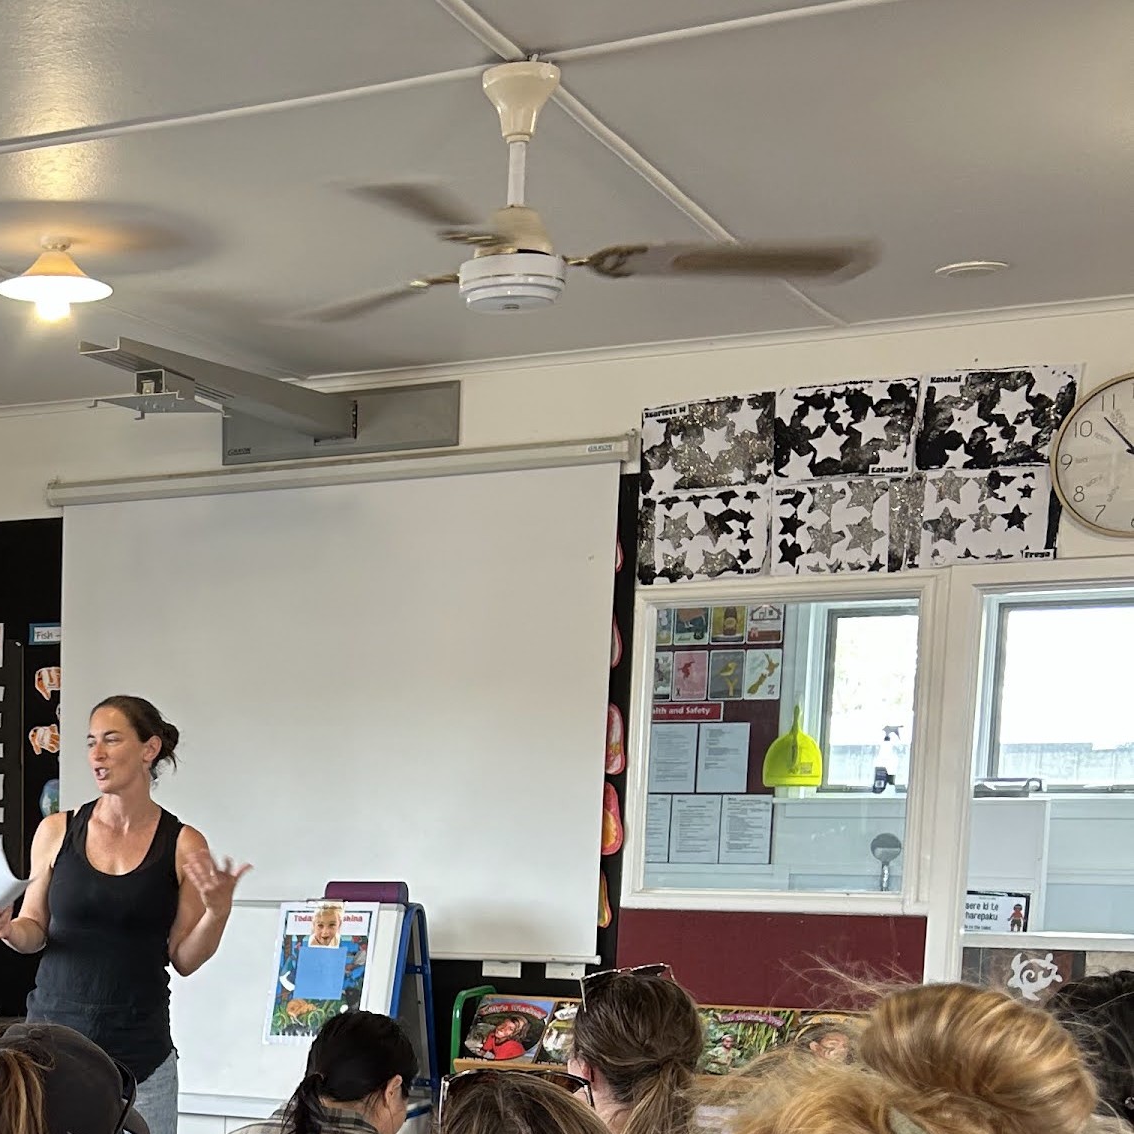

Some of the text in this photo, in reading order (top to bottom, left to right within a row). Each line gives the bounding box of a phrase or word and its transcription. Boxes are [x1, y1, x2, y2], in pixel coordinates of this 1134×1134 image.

[1102, 393, 1115, 412] 11
[1074, 420, 1092, 438] 10
[1060, 454, 1072, 470] 9
[1073, 486, 1085, 502] 8
[1095, 504, 1106, 522] 7
[36, 631, 53, 640] Fish
[768, 684, 775, 695] Z
[686, 706, 710, 716] Safety
[991, 902, 998, 911] te
[966, 911, 998, 922] harepaku
